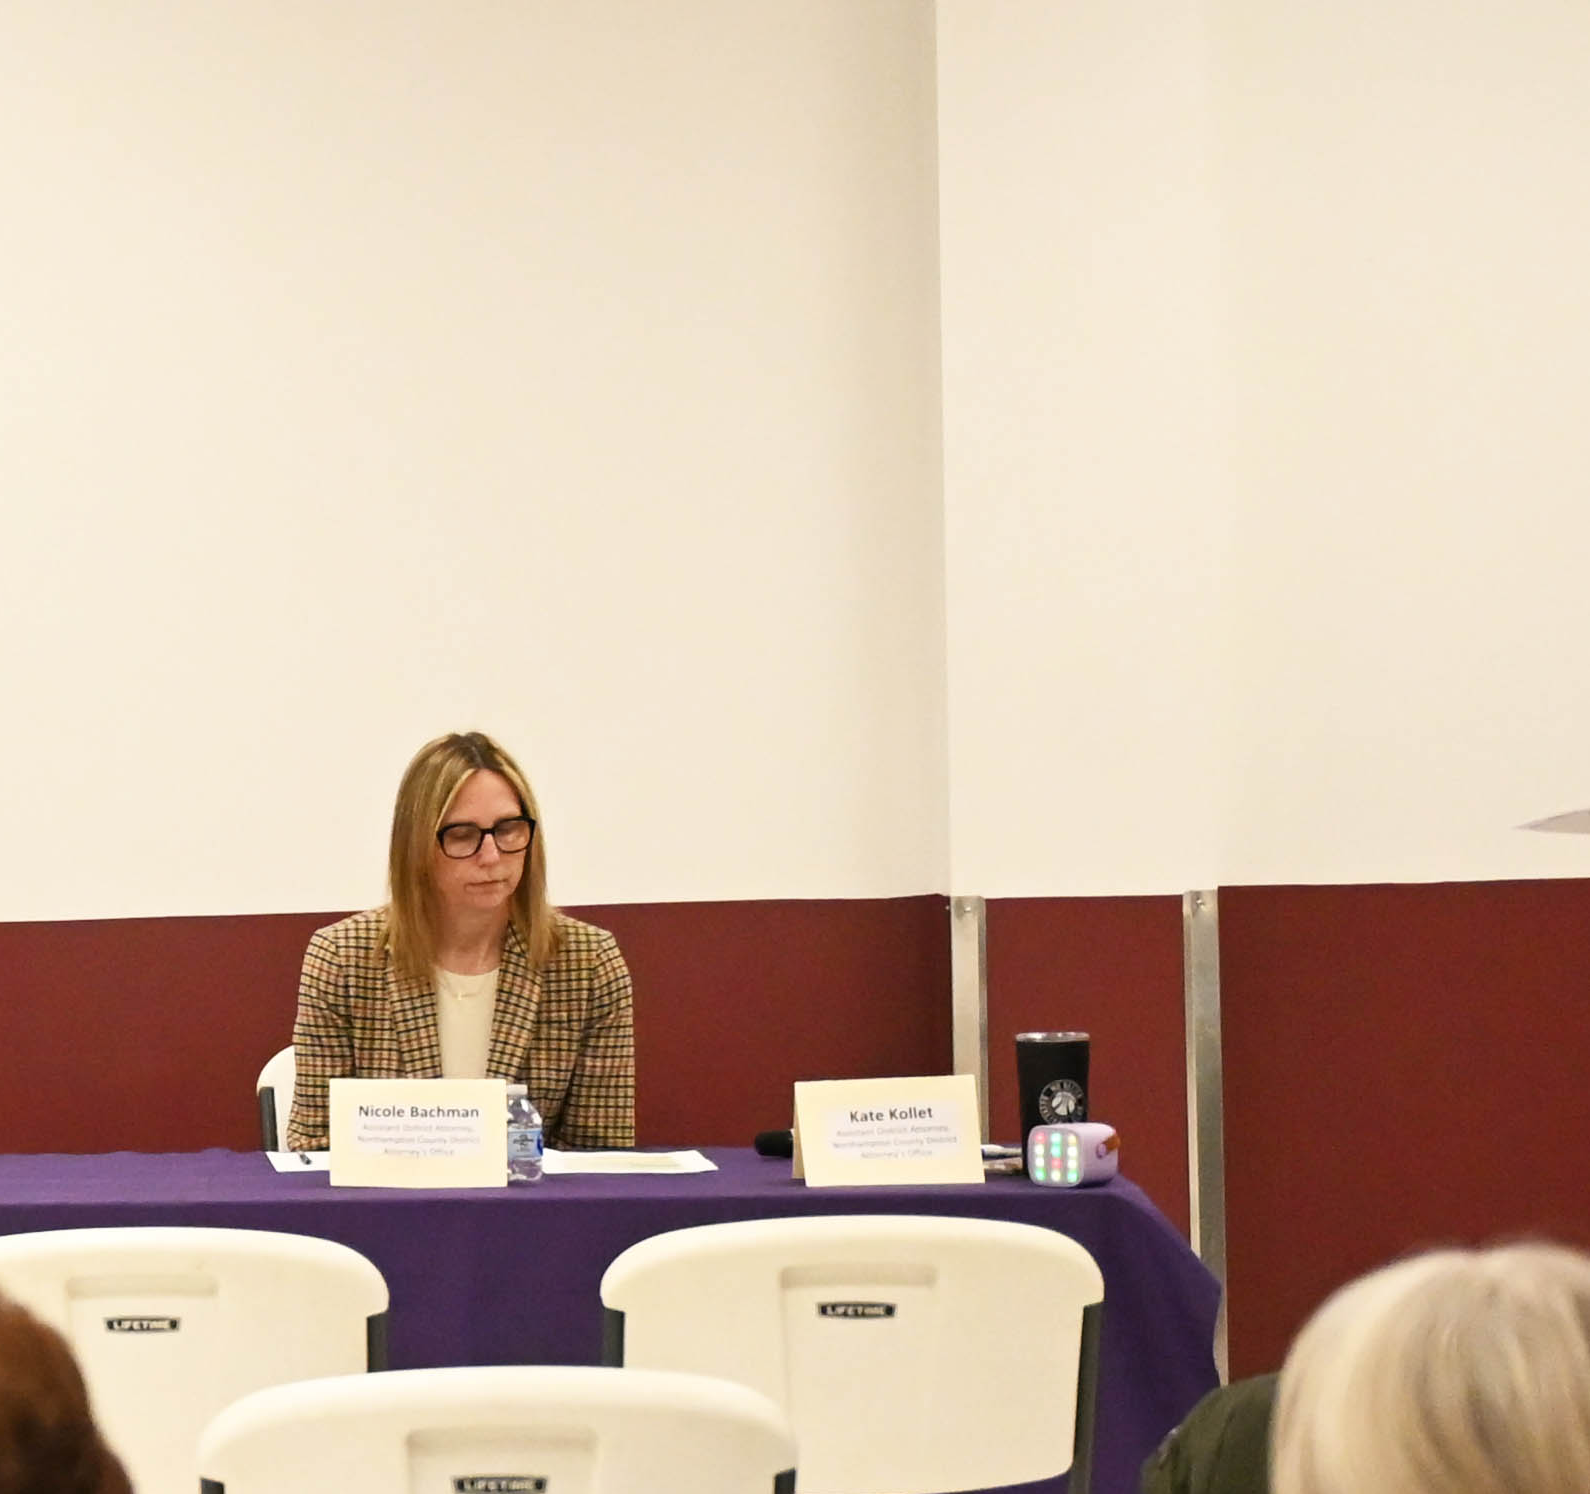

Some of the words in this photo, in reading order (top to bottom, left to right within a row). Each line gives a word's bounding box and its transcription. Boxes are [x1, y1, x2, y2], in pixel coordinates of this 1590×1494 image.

[358, 1105, 405, 1118] Nicole
[410, 1105, 479, 1118] Bachman
[850, 1109, 884, 1123] Kate
[890, 1107, 933, 1120] Kollet
[827, 1305, 885, 1315] LIFETIME
[113, 1320, 169, 1330] LIFETIME
[464, 1479, 535, 1490] LIFETIME
